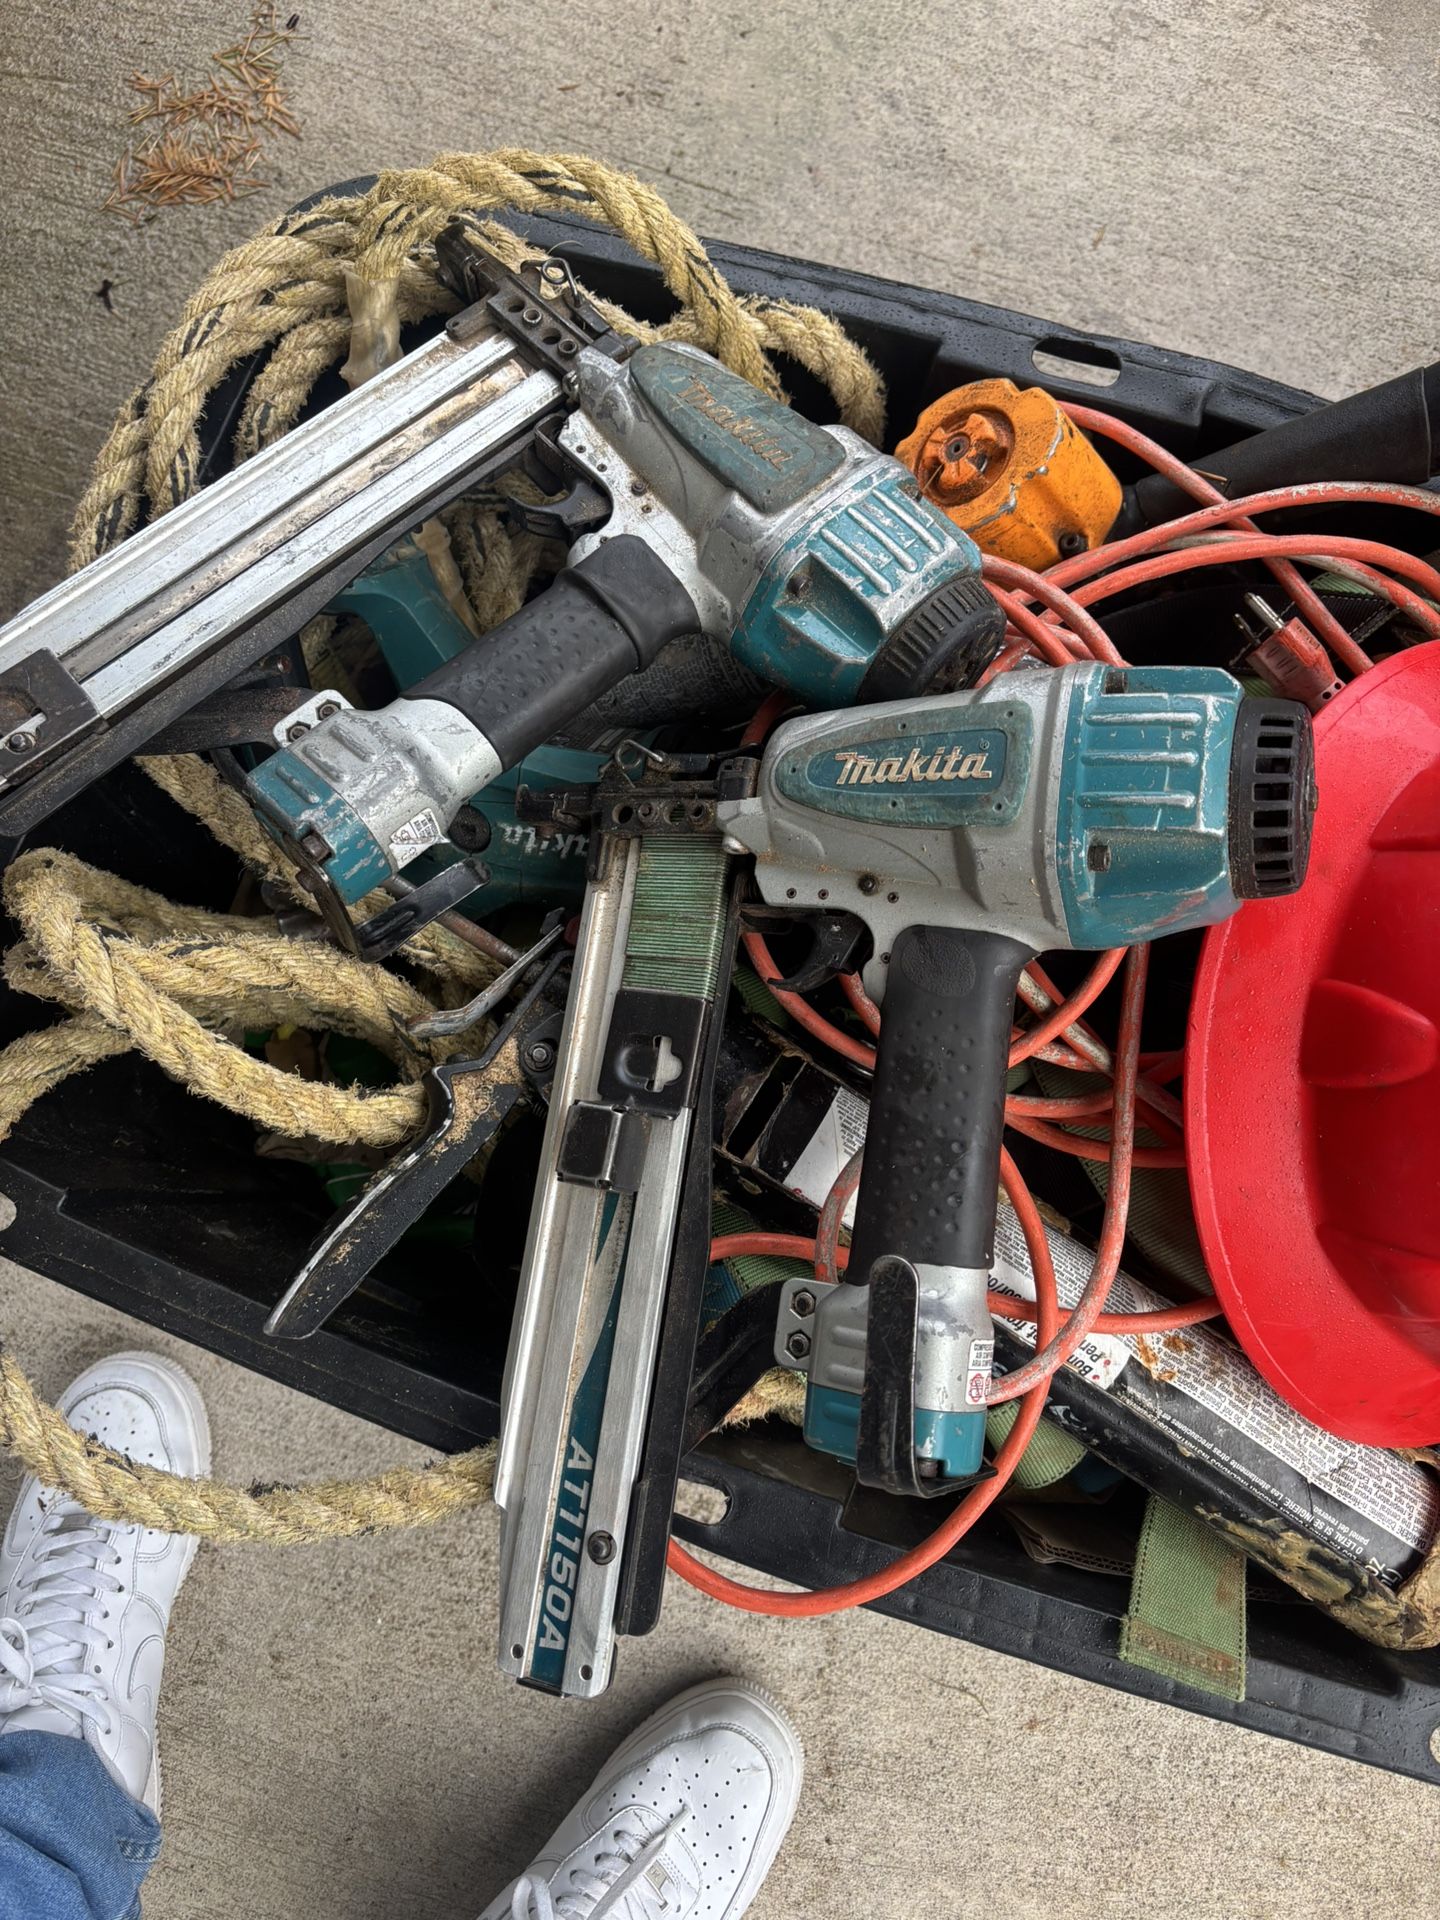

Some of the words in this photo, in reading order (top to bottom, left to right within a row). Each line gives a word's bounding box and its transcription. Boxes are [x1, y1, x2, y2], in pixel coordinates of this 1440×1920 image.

[498, 823, 589, 859] akita
[1169, 1417, 1214, 1450] precauciones
[1210, 1446, 1231, 1463] otras
[1227, 1458, 1272, 1492] atentamente
[1268, 1486, 1284, 1501] Lea
[1280, 1495, 1315, 1523] INGIERE.
[1309, 1503, 1339, 1527] reverso.
[1311, 1517, 1326, 1531] SE
[1322, 1524, 1335, 1536] SI
[1336, 1521, 1350, 1535] del
[538, 1436, 593, 1651] AT1150A
[1331, 1530, 1357, 1551] LETAL
[1347, 1528, 1370, 1547] panel
